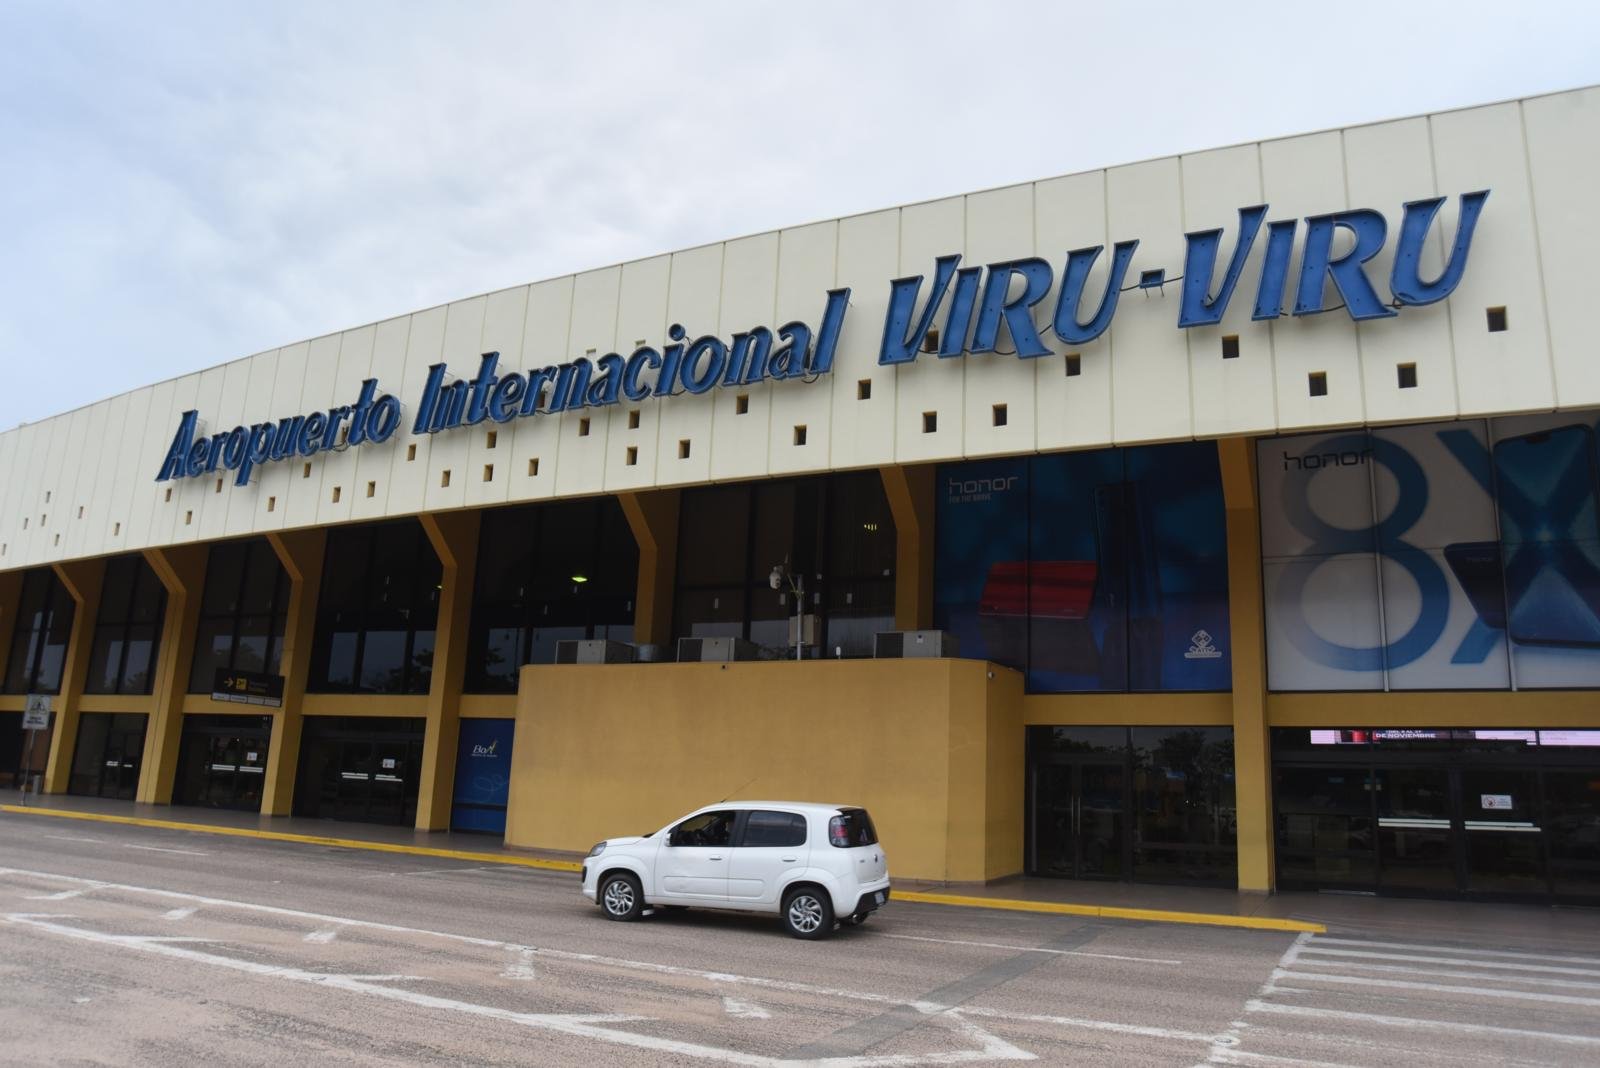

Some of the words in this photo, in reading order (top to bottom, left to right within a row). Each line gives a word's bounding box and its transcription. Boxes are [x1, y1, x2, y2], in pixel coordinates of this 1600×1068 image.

[155, 378, 401, 487] Aeropuerto
[412, 287, 851, 435] Internacional
[878, 189, 1491, 366] VIRU-VIRU
[1283, 448, 1375, 471] honor
[948, 476, 1019, 495] honor
